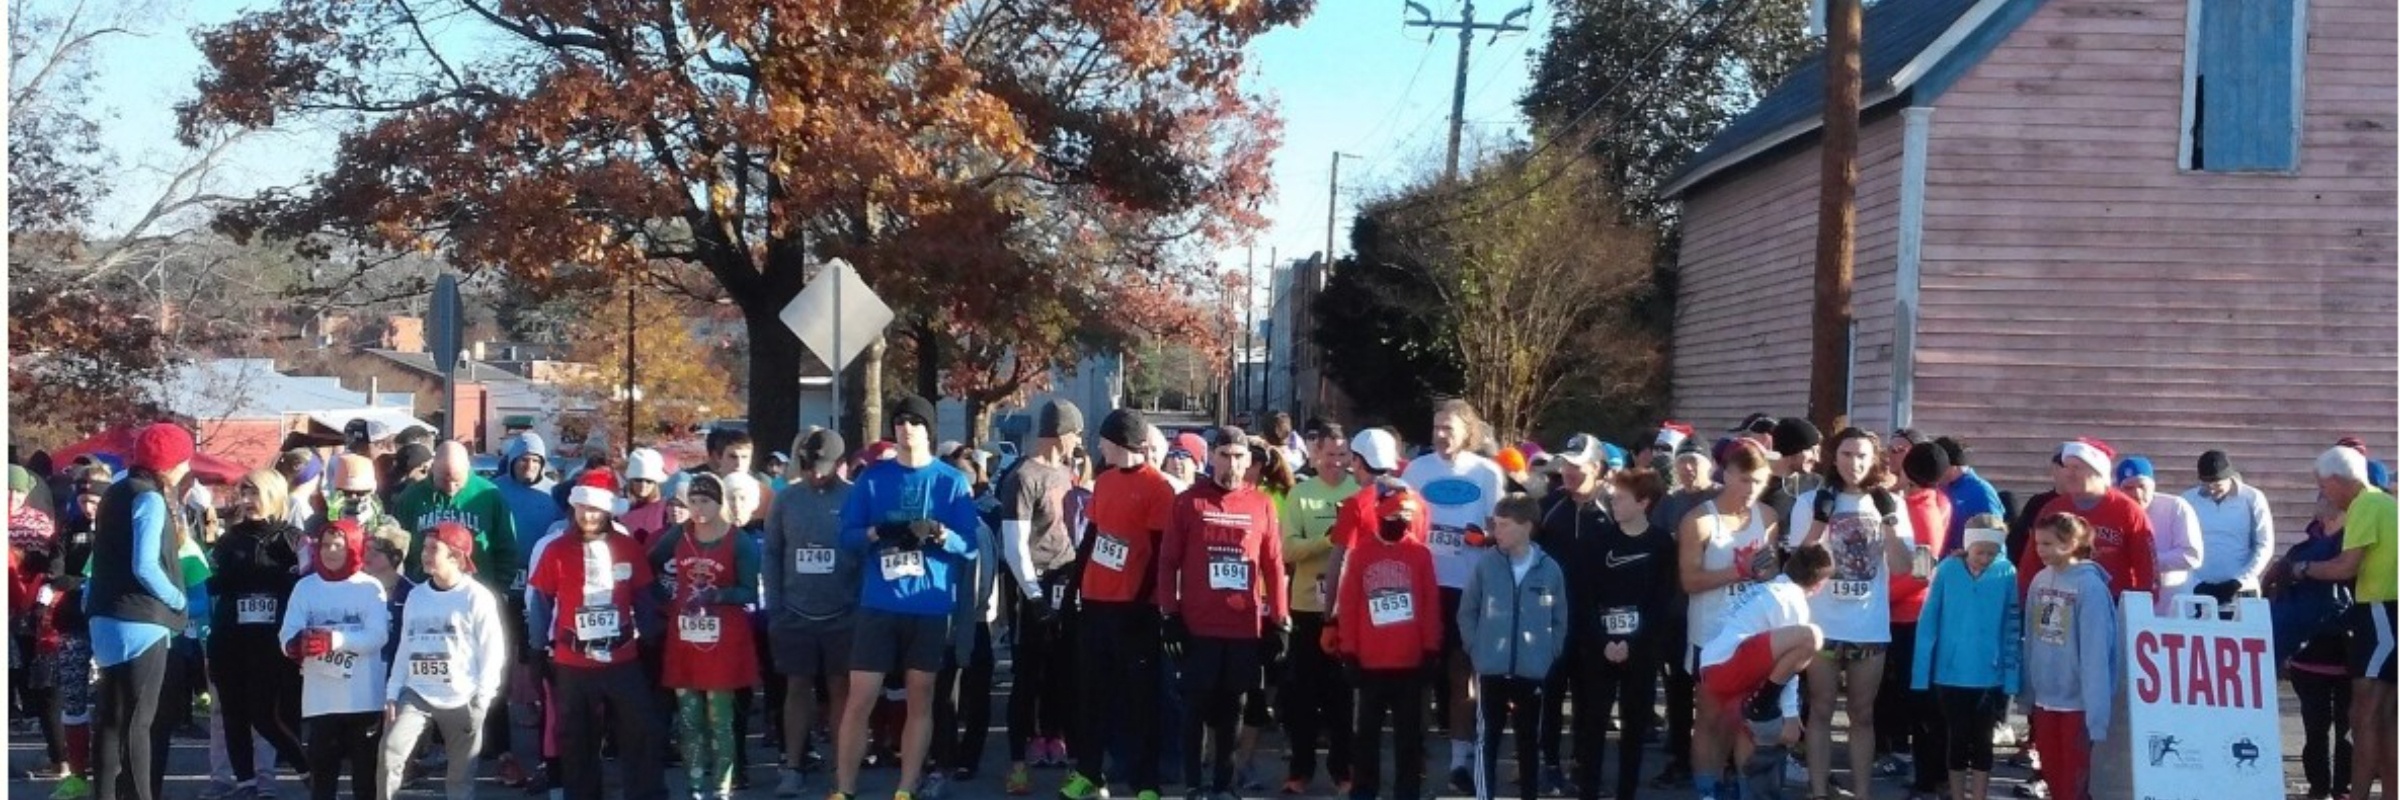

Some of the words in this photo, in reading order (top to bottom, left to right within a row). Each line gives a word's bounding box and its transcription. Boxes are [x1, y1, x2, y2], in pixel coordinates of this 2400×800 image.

[798, 550, 832, 563] 1740
[1832, 582, 1868, 596] 1949
[1372, 595, 1408, 613] 1659
[413, 661, 448, 675] 1853
[2135, 630, 2267, 709] START
